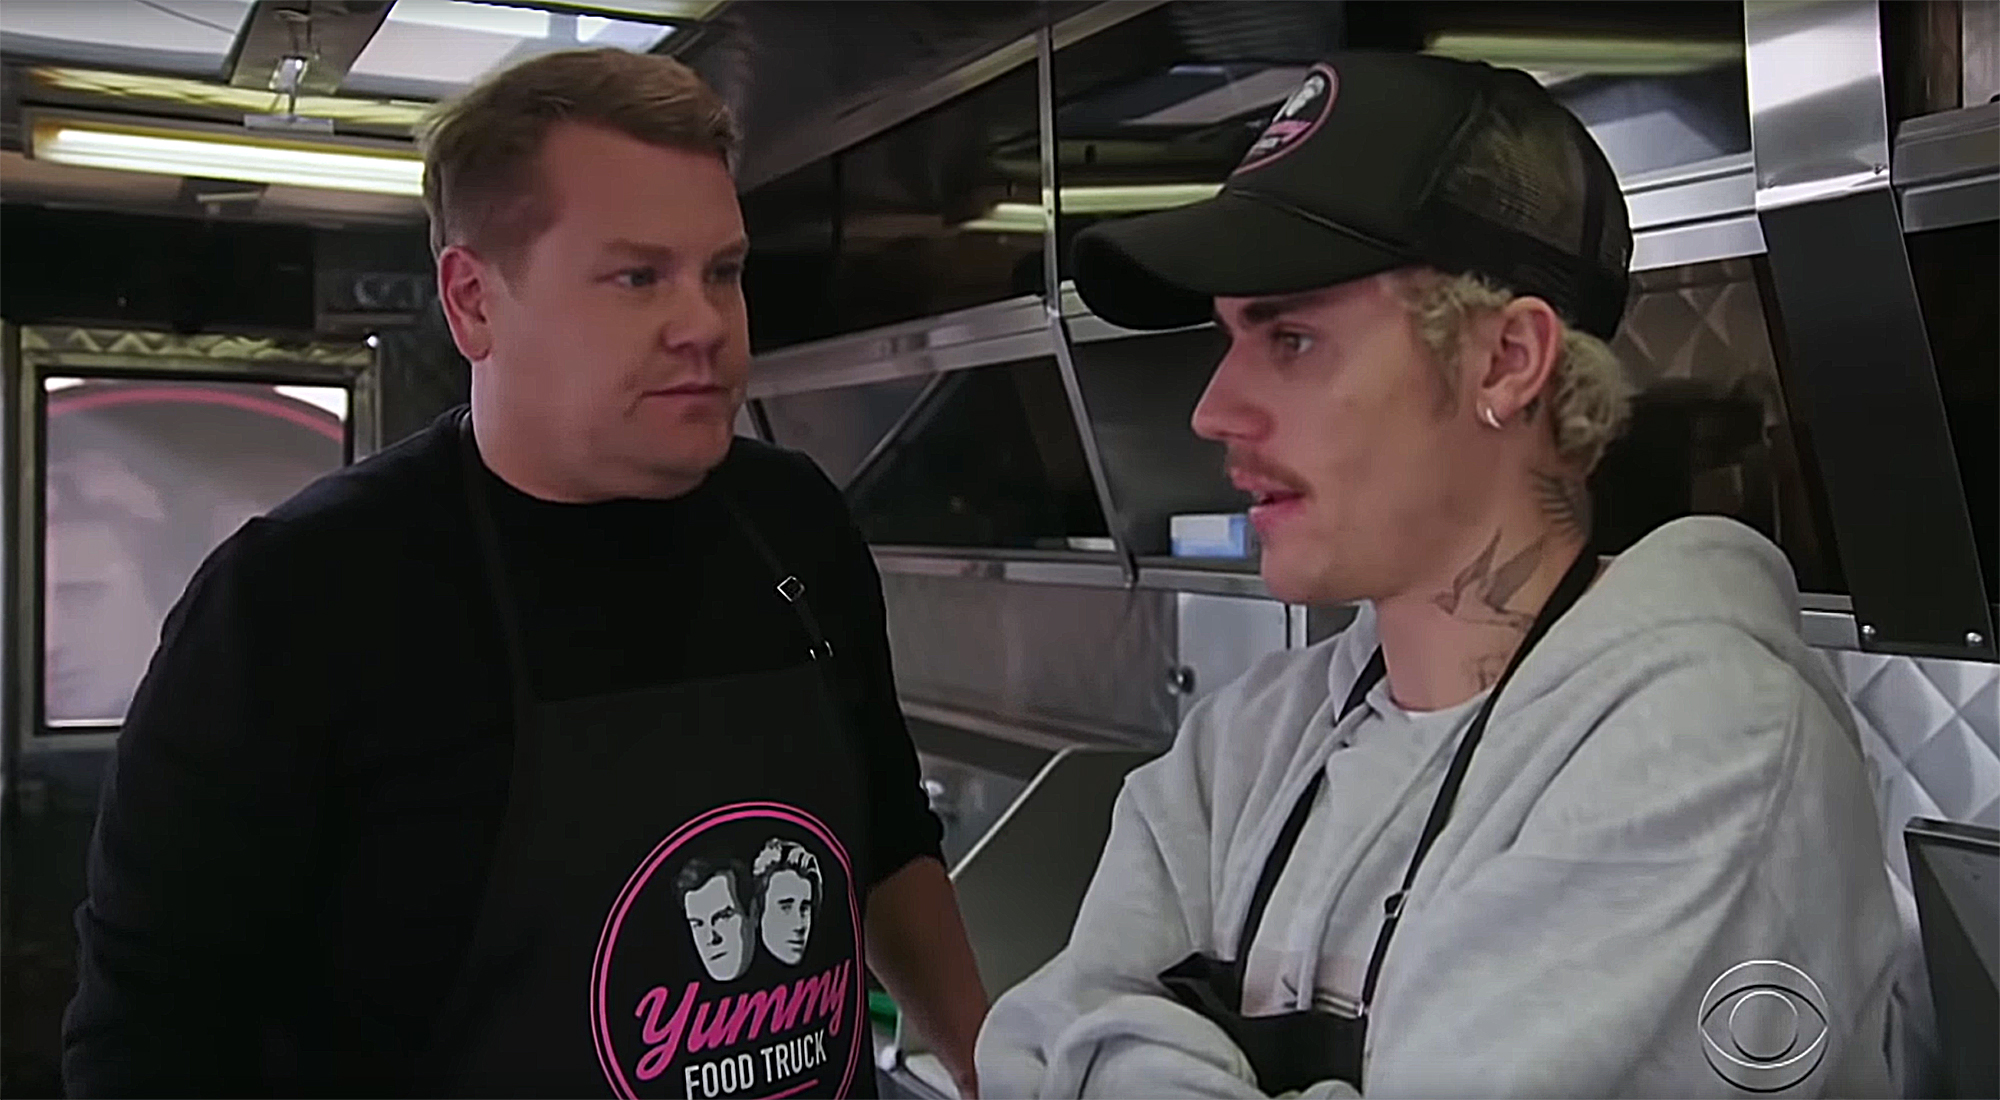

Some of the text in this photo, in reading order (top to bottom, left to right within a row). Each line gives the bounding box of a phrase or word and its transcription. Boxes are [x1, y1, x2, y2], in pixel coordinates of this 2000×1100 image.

[635, 959, 850, 1080] Yummy
[684, 1028, 828, 1100] FOOD TRUCK
